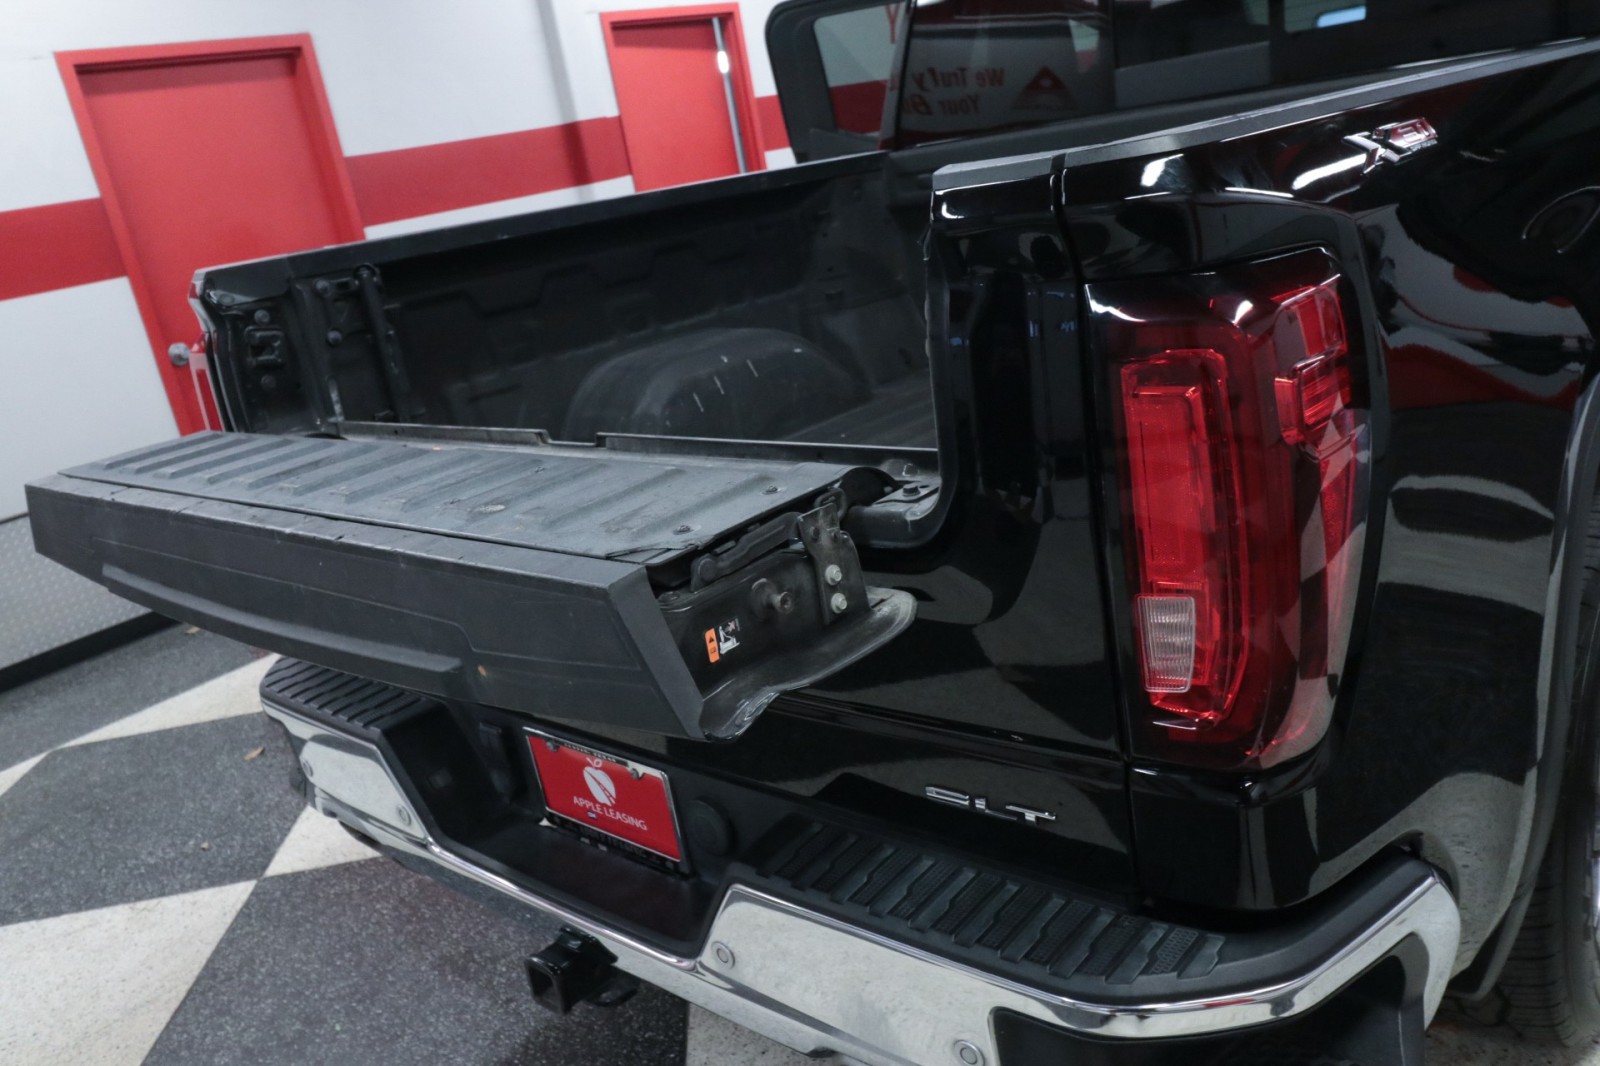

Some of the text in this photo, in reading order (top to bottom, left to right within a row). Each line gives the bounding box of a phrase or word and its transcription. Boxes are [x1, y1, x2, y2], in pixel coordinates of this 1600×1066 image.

[573, 796, 648, 831] APPLE LEASING
[925, 786, 1056, 823] SLT
